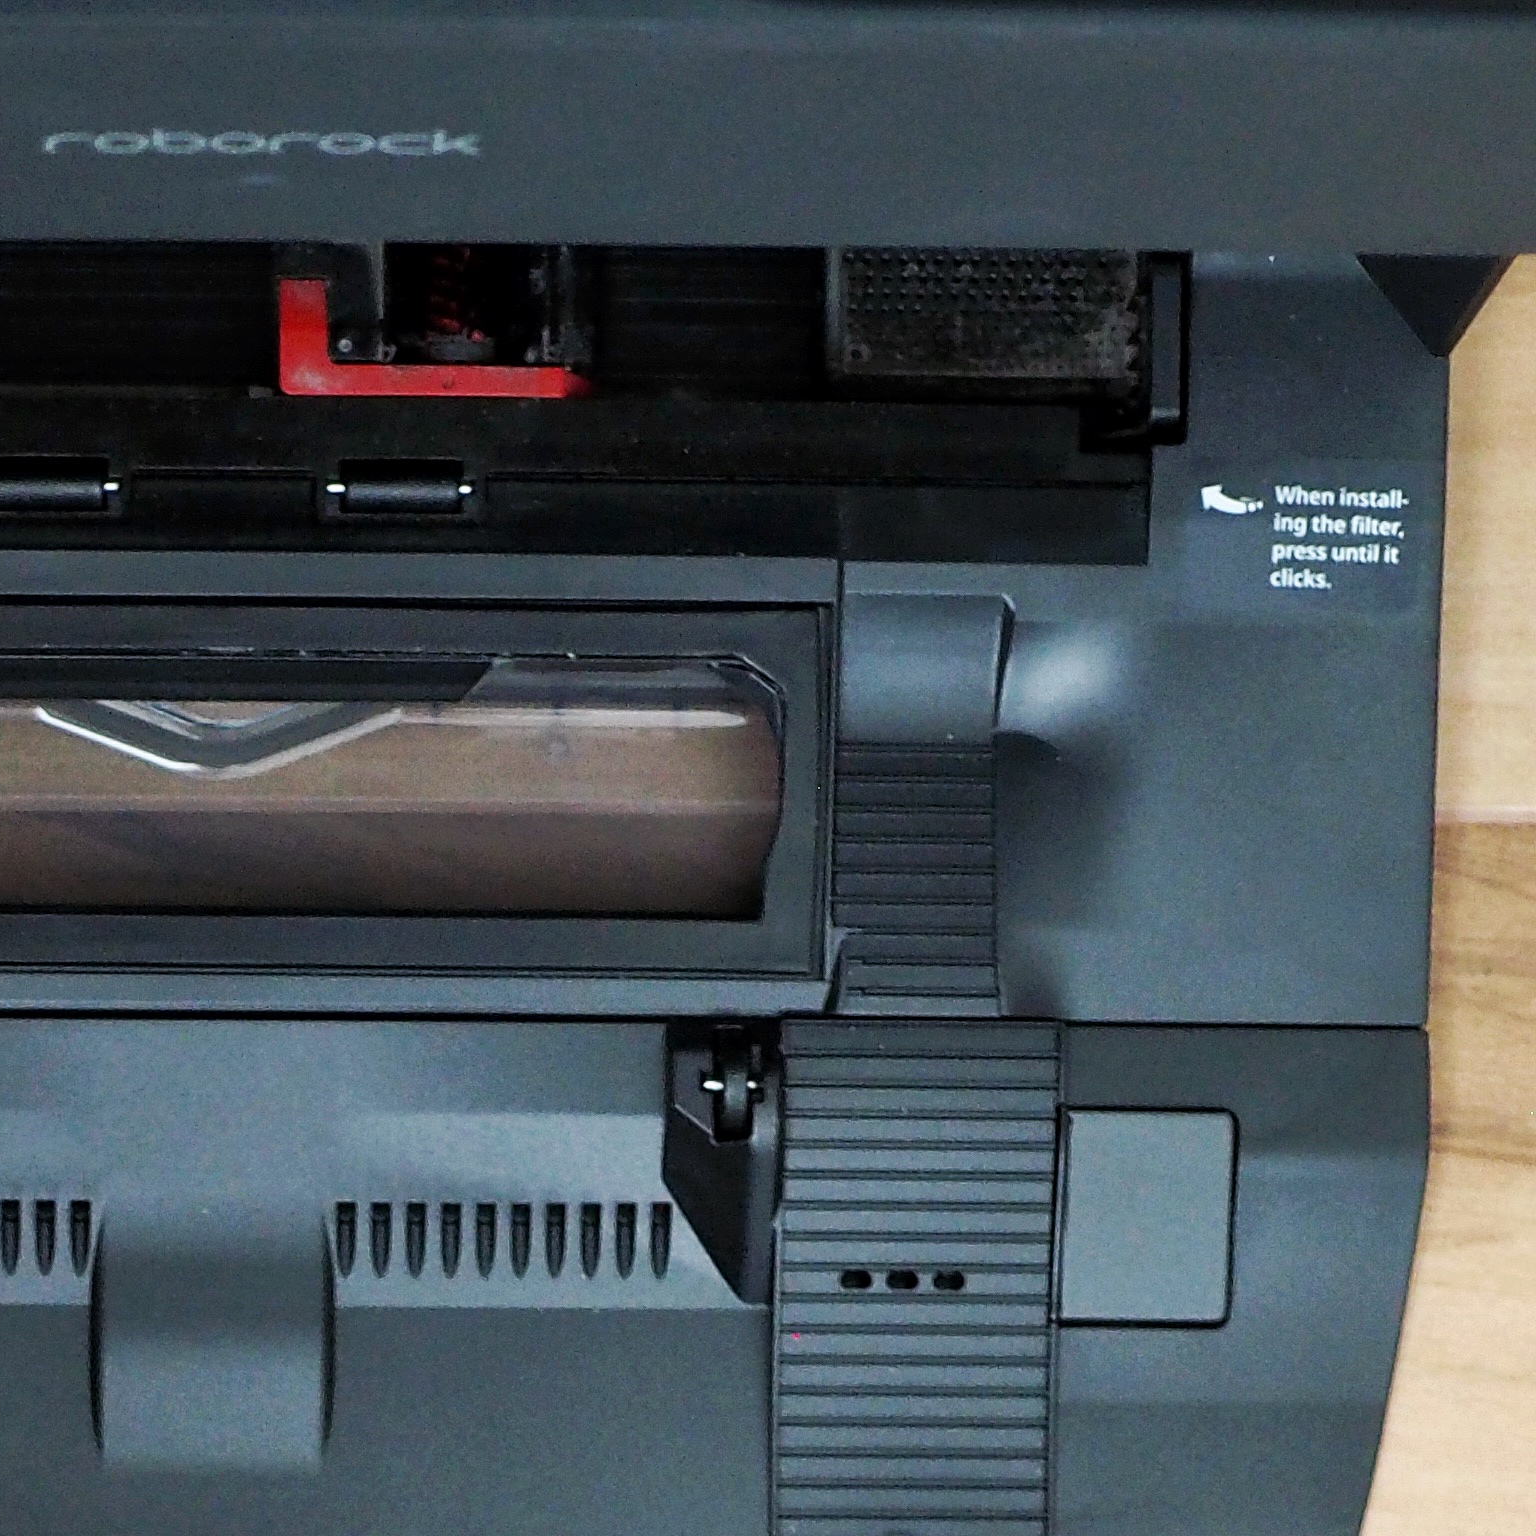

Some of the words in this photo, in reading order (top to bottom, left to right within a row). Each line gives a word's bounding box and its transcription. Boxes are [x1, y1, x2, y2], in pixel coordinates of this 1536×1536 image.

[41, 127, 480, 155] roborock
[1274, 485, 1335, 506] When
[1339, 487, 1409, 509] install-
[1273, 513, 1307, 537] ing
[1311, 514, 1346, 534] the
[1270, 544, 1327, 565] press
[1331, 543, 1379, 563] until
[1383, 544, 1400, 564] it
[1269, 568, 1332, 589] clicks.
